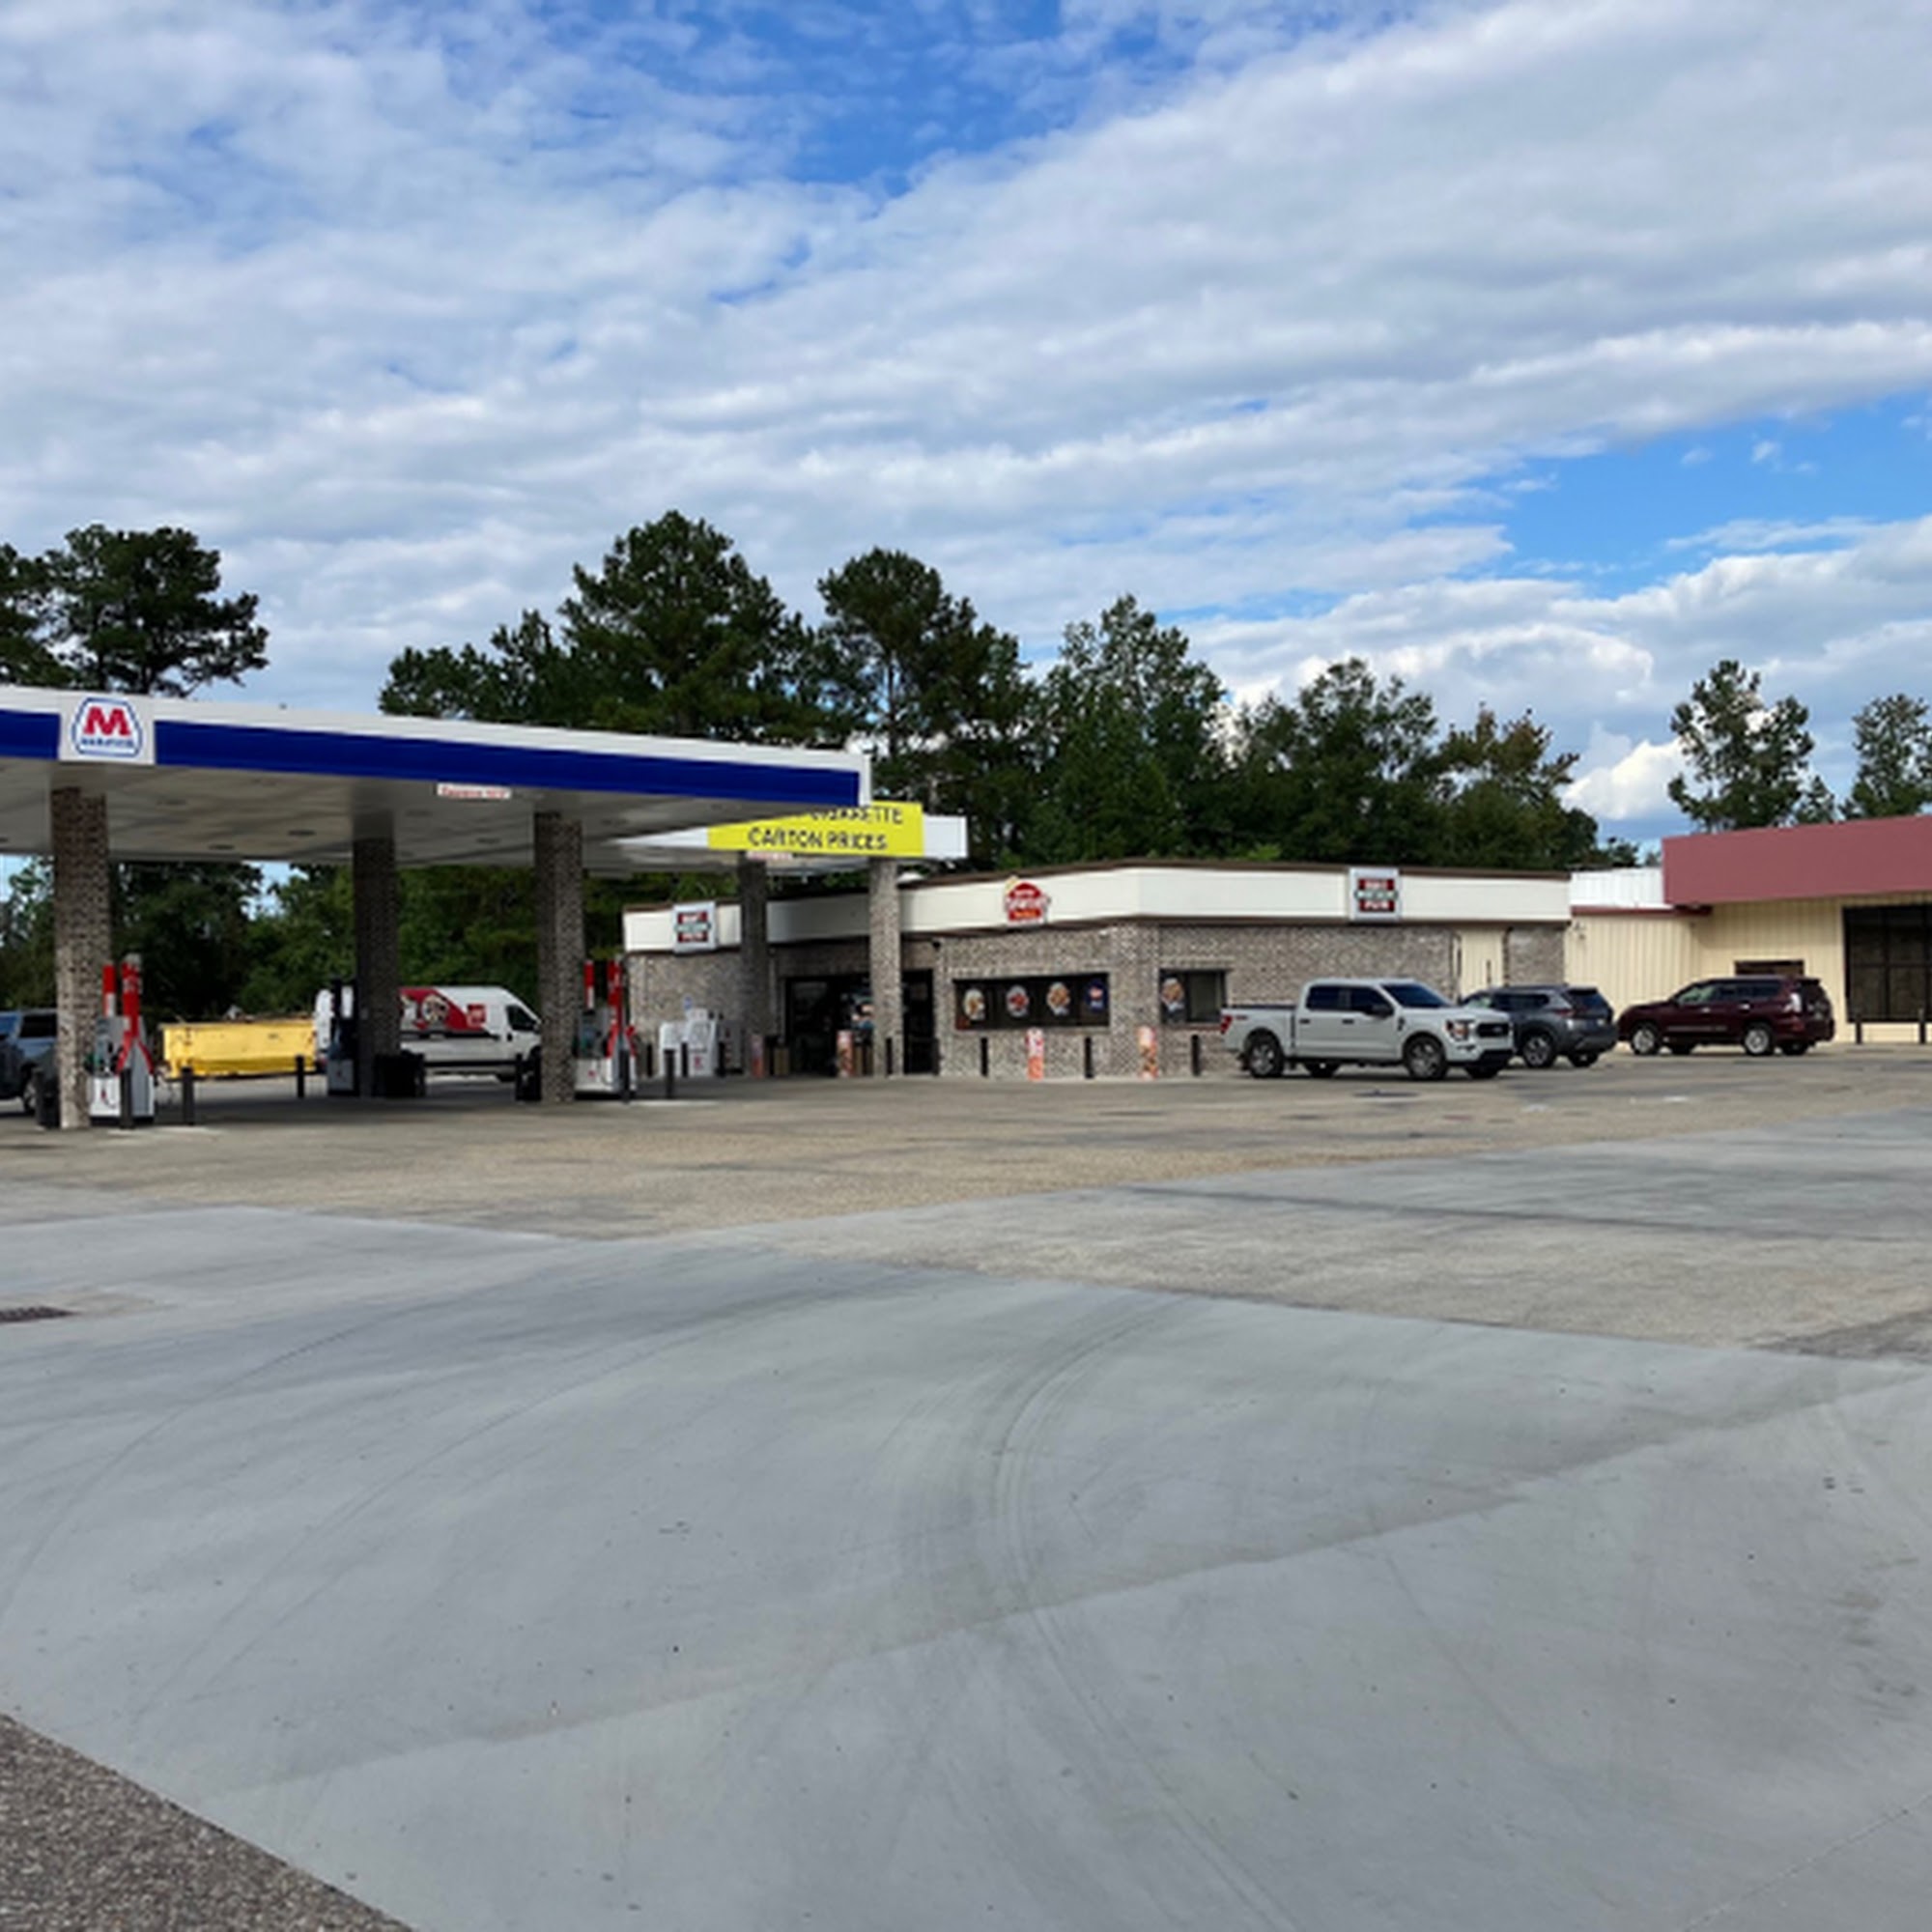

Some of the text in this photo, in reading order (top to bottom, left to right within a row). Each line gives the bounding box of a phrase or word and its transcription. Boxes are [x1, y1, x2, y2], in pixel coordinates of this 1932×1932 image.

[83, 706, 131, 736] M
[748, 827, 887, 850] CARTON PRICES
